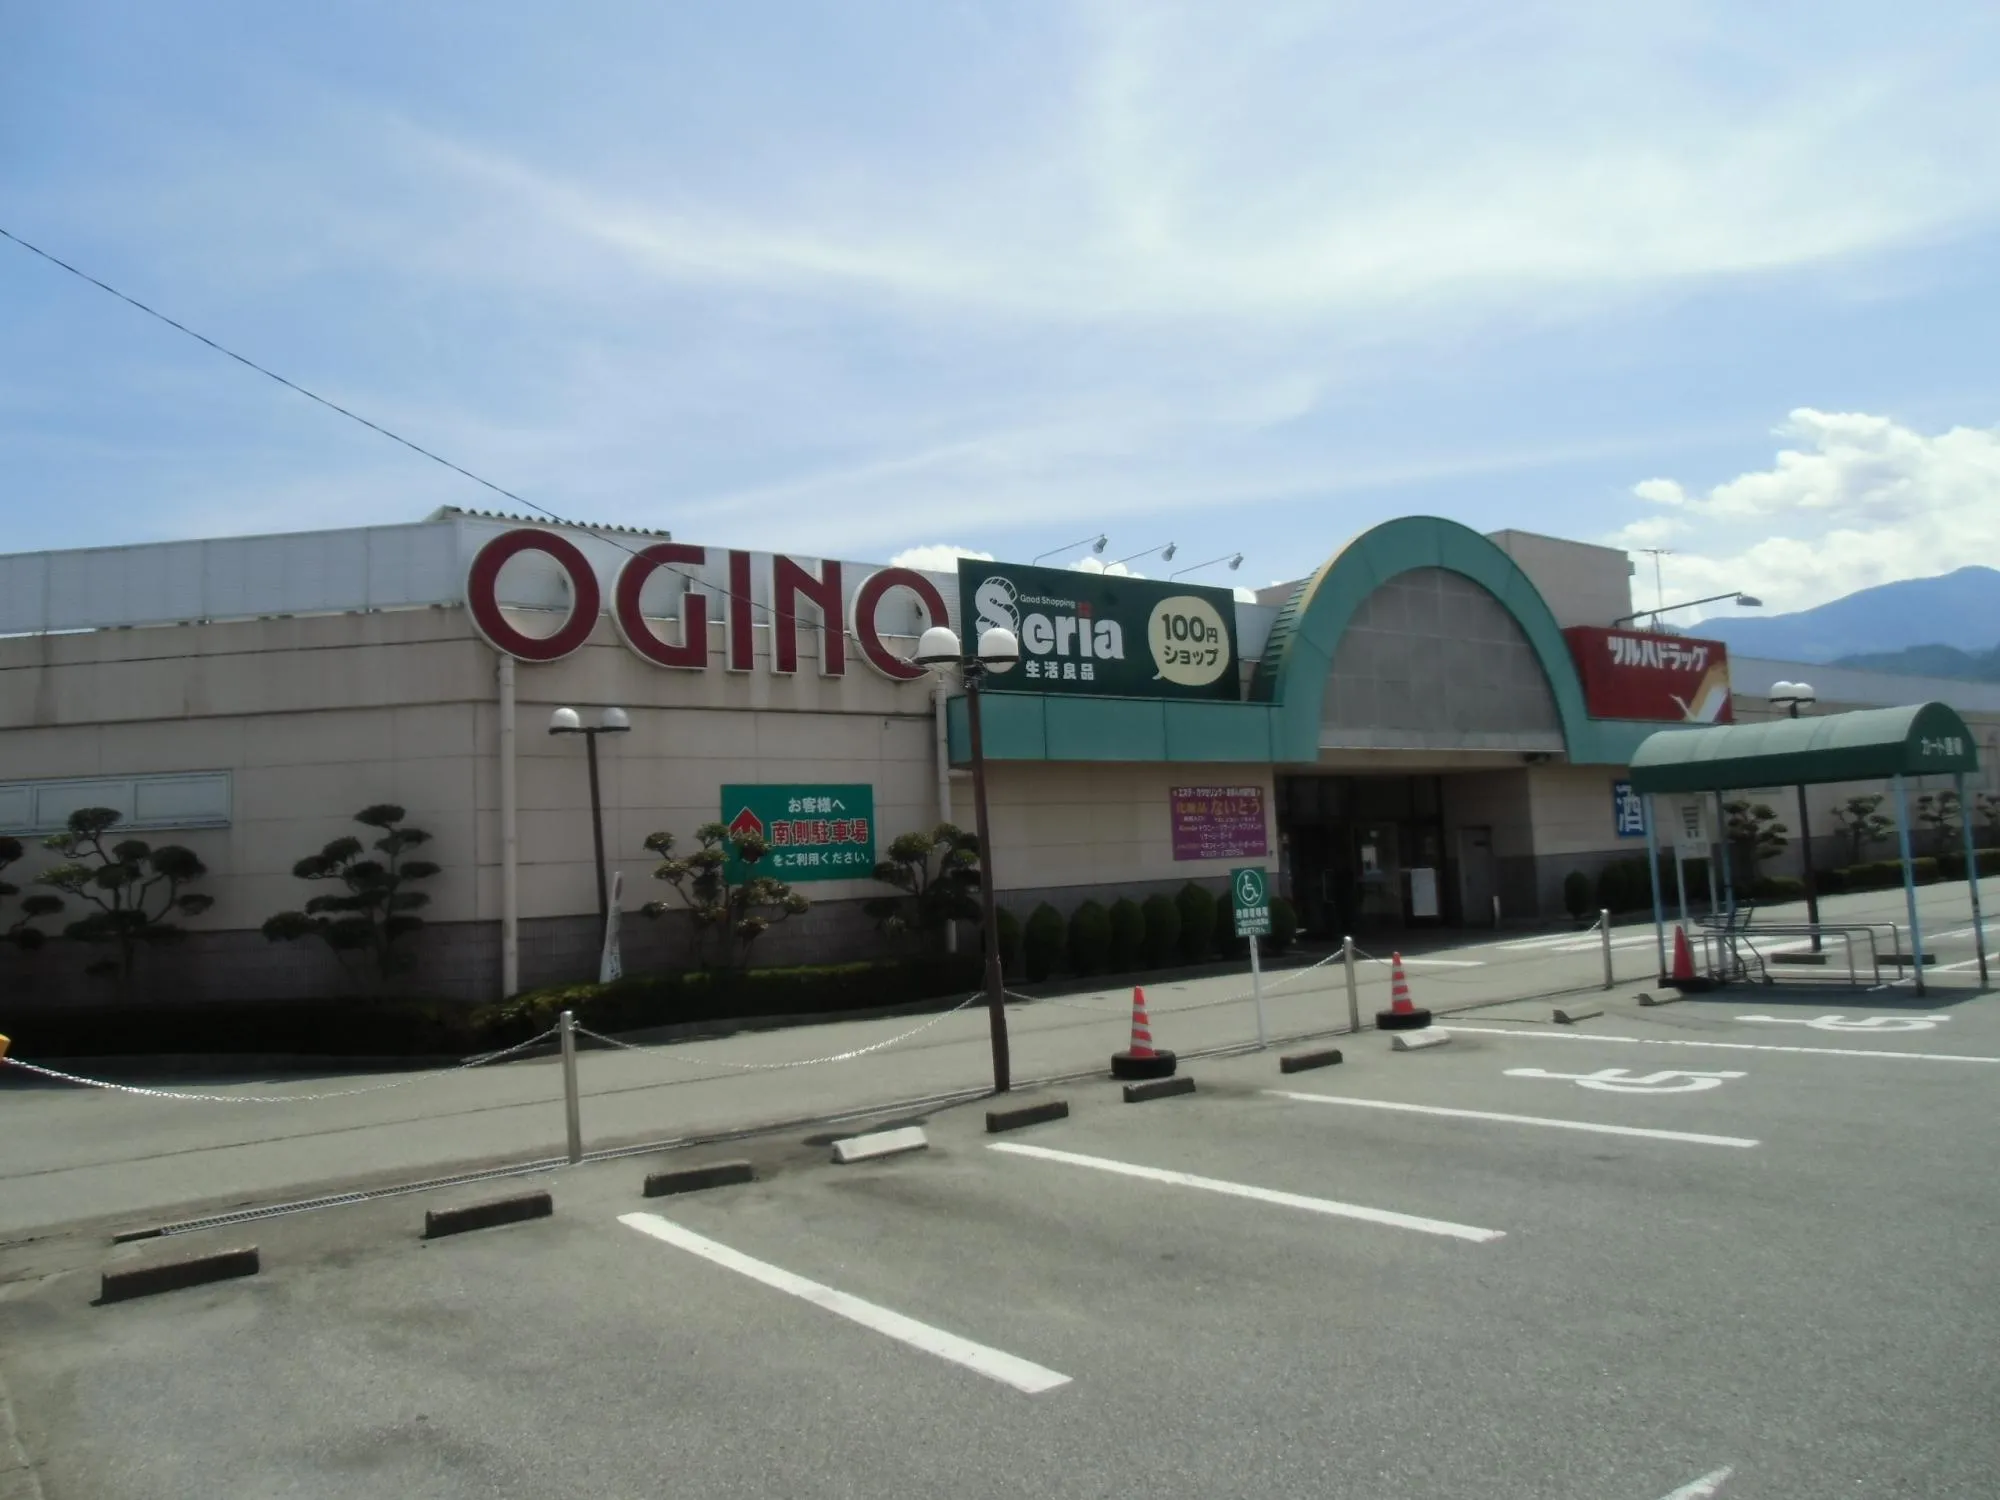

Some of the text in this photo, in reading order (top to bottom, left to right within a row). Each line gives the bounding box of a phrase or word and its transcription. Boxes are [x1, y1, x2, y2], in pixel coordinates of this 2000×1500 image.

[467, 528, 949, 680] OGINO
[1020, 594, 1077, 609] Good Shopping
[975, 576, 1124, 660] Seria
[1162, 614, 1218, 643] 100円
[1164, 646, 1219, 667] ショップ
[1607, 636, 1709, 672] ツルハドラッグ
[1025, 660, 1095, 681] 生活良品
[788, 797, 846, 813] お客様へ
[771, 818, 868, 846] 南側駐車場
[773, 852, 870, 867] をご利用ください。
